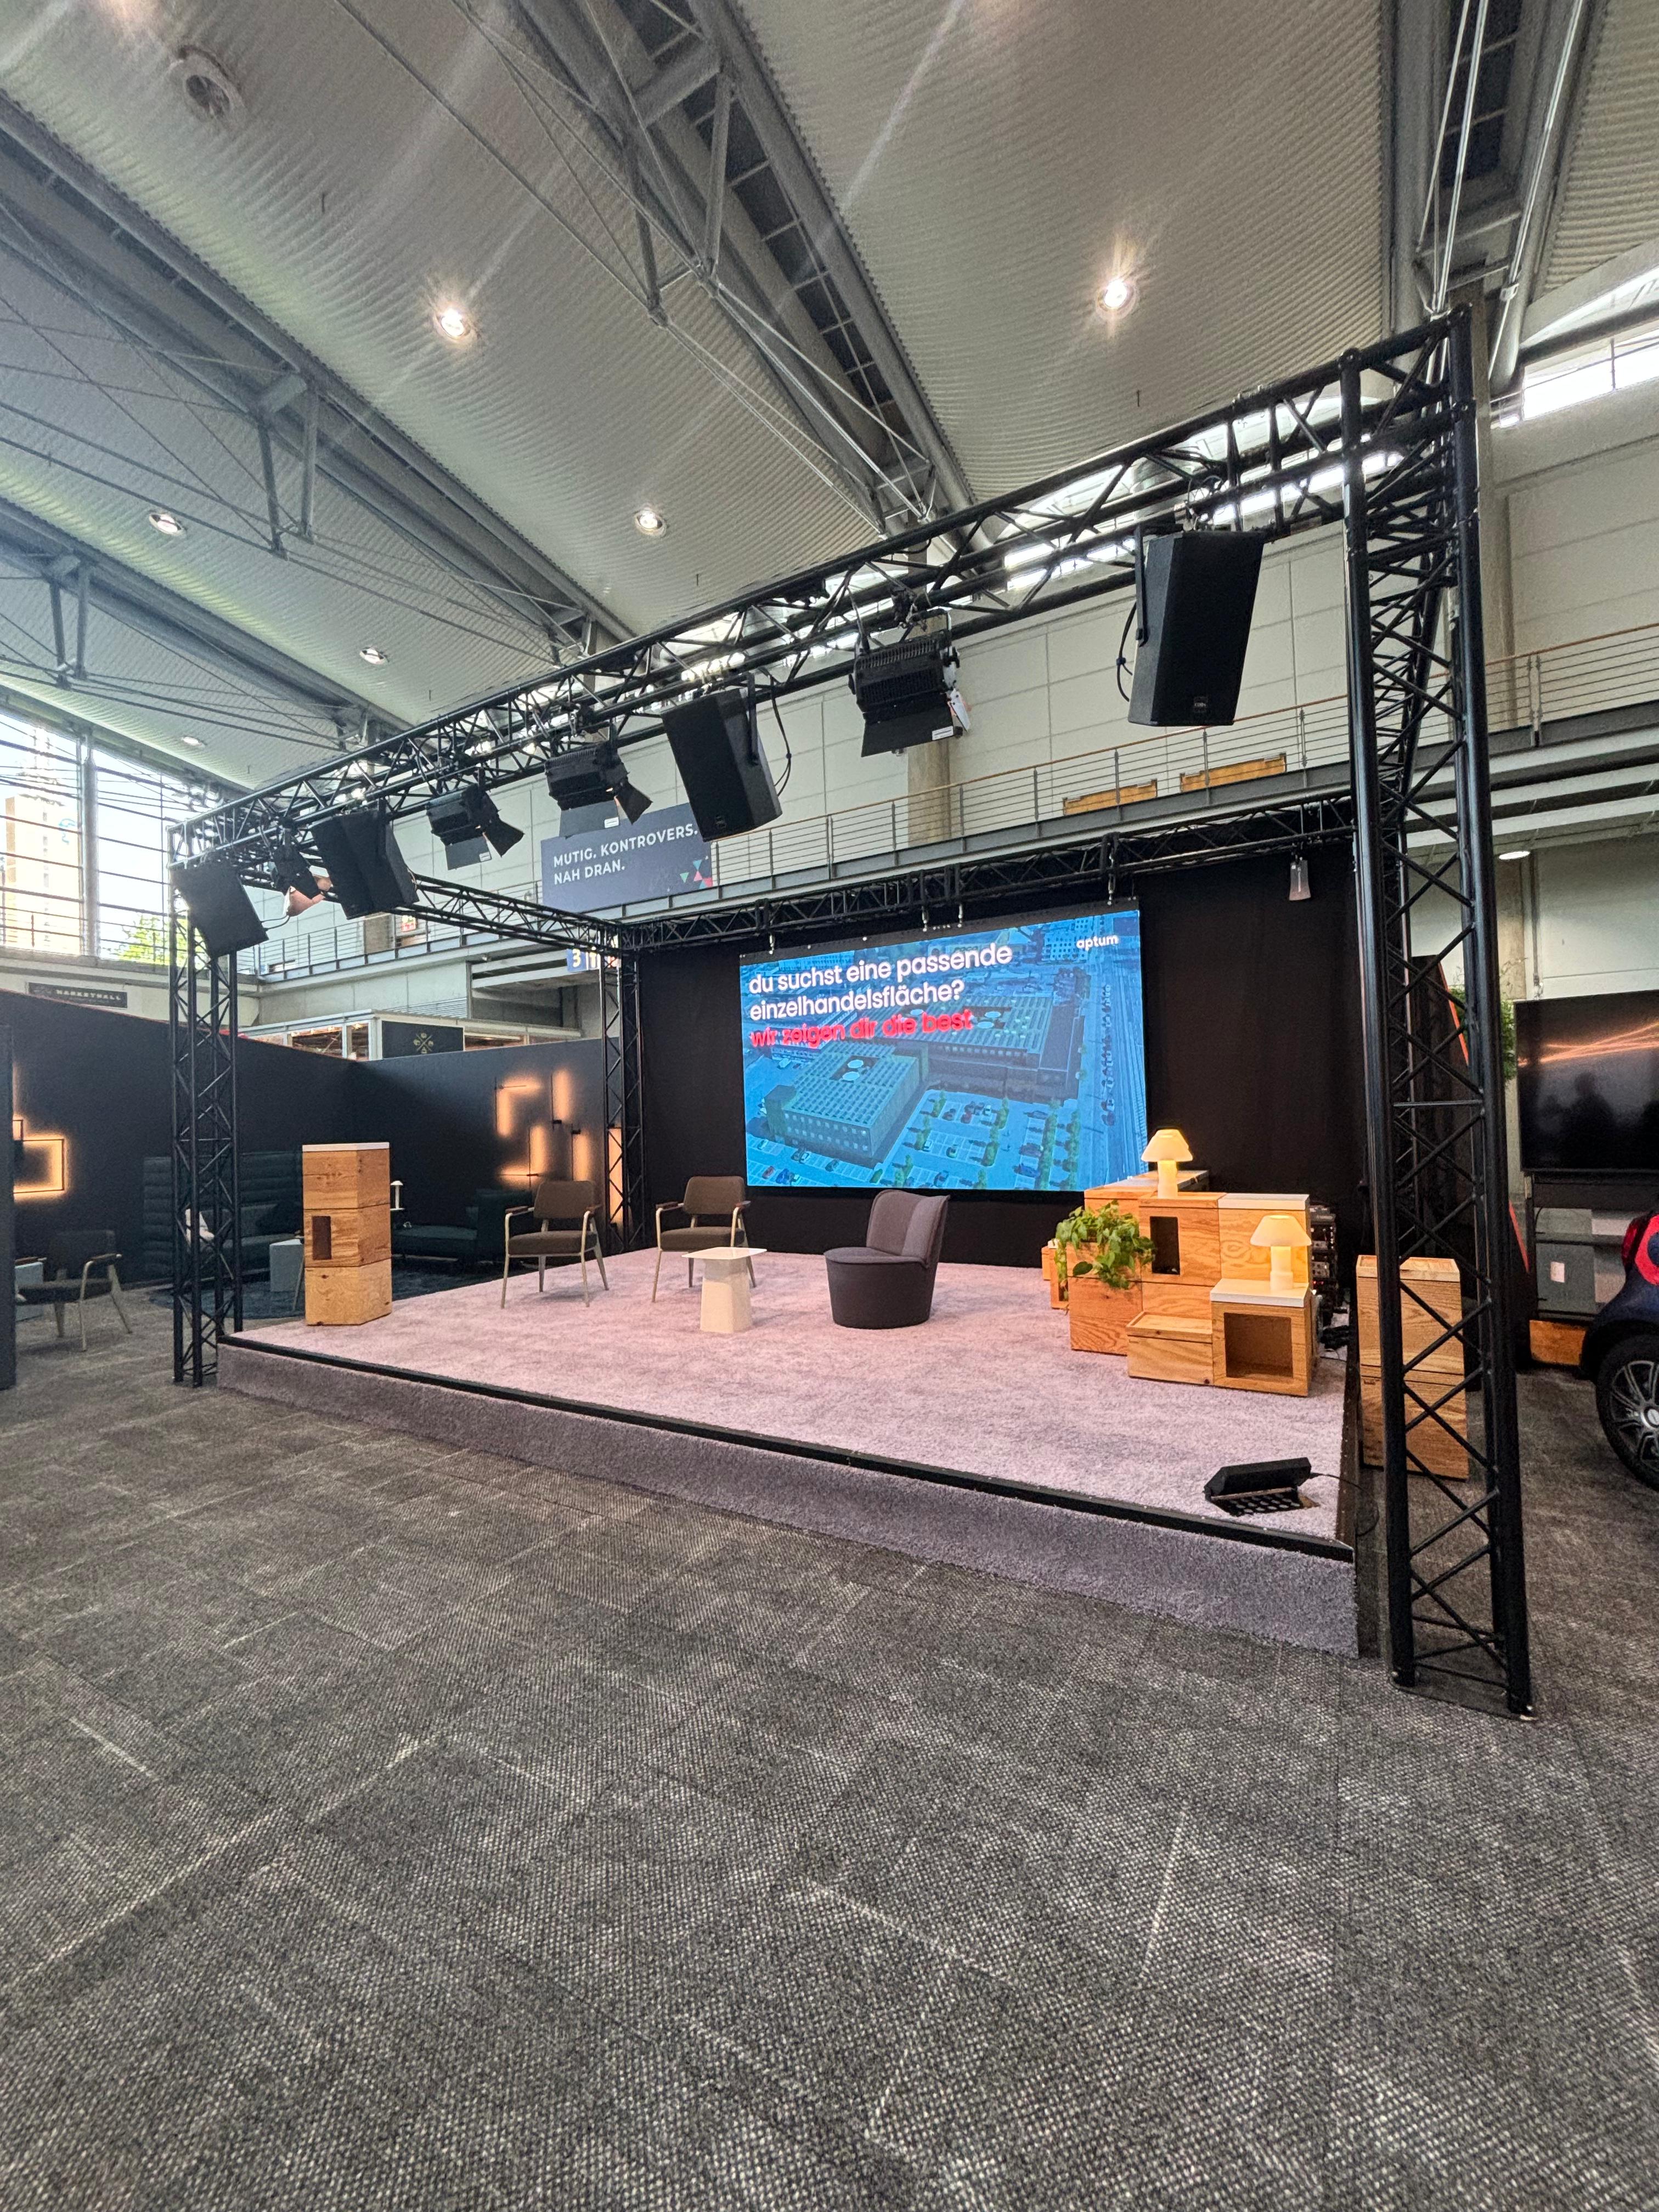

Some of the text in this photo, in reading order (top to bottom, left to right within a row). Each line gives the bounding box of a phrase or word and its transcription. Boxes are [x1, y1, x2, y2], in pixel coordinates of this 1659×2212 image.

[554, 823, 698, 867] MUTIG. KONTROVERS.
[554, 859, 625, 885] NAH DRAN.
[1076, 935, 1119, 952] aptum
[749, 942, 1013, 994] du suchst eine passende
[750, 979, 965, 1021] einzelhandelsfläche?
[751, 1009, 974, 1048] wir zeigen dir die best
